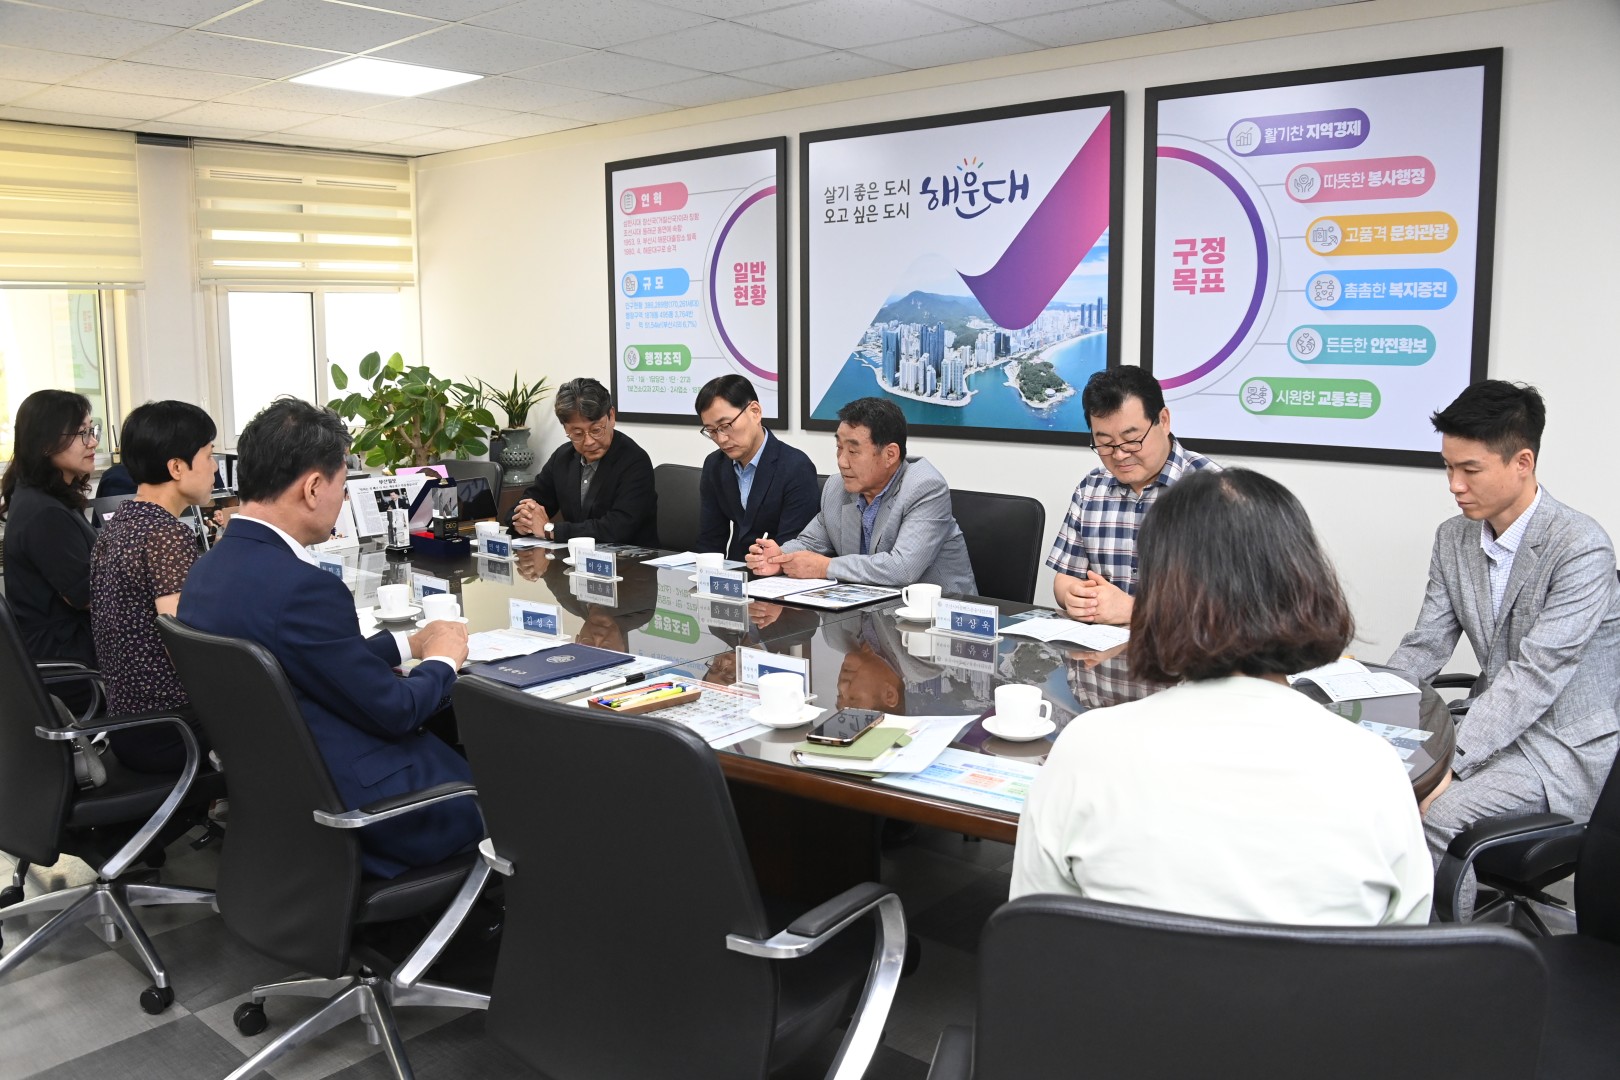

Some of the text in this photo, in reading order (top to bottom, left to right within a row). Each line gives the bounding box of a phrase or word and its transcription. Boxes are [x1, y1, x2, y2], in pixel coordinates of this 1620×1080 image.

[1264, 119, 1362, 144] 활기찬 지역경제
[1323, 167, 1426, 190] 따뜻한 봉사행정
[824, 178, 911, 204] 살기 좋은 도시
[919, 169, 1030, 220] 해운대
[823, 202, 910, 224] 오고 싶은 도시
[1344, 223, 1450, 244] 고품격 문화관광
[1173, 236, 1226, 266] 구정
[643, 276, 664, 290] 규모
[733, 261, 766, 284] 일반
[1172, 267, 1225, 295] 목표
[733, 285, 766, 307] 현황
[1344, 281, 1447, 299] 촘촘한 복지증진
[1326, 336, 1428, 355] 든든한 안전확보
[645, 351, 682, 366] 행정조직
[1276, 389, 1373, 408] 시원한 교통흐름
[526, 615, 554, 629] 김성수
[955, 616, 991, 632] 김상욱
